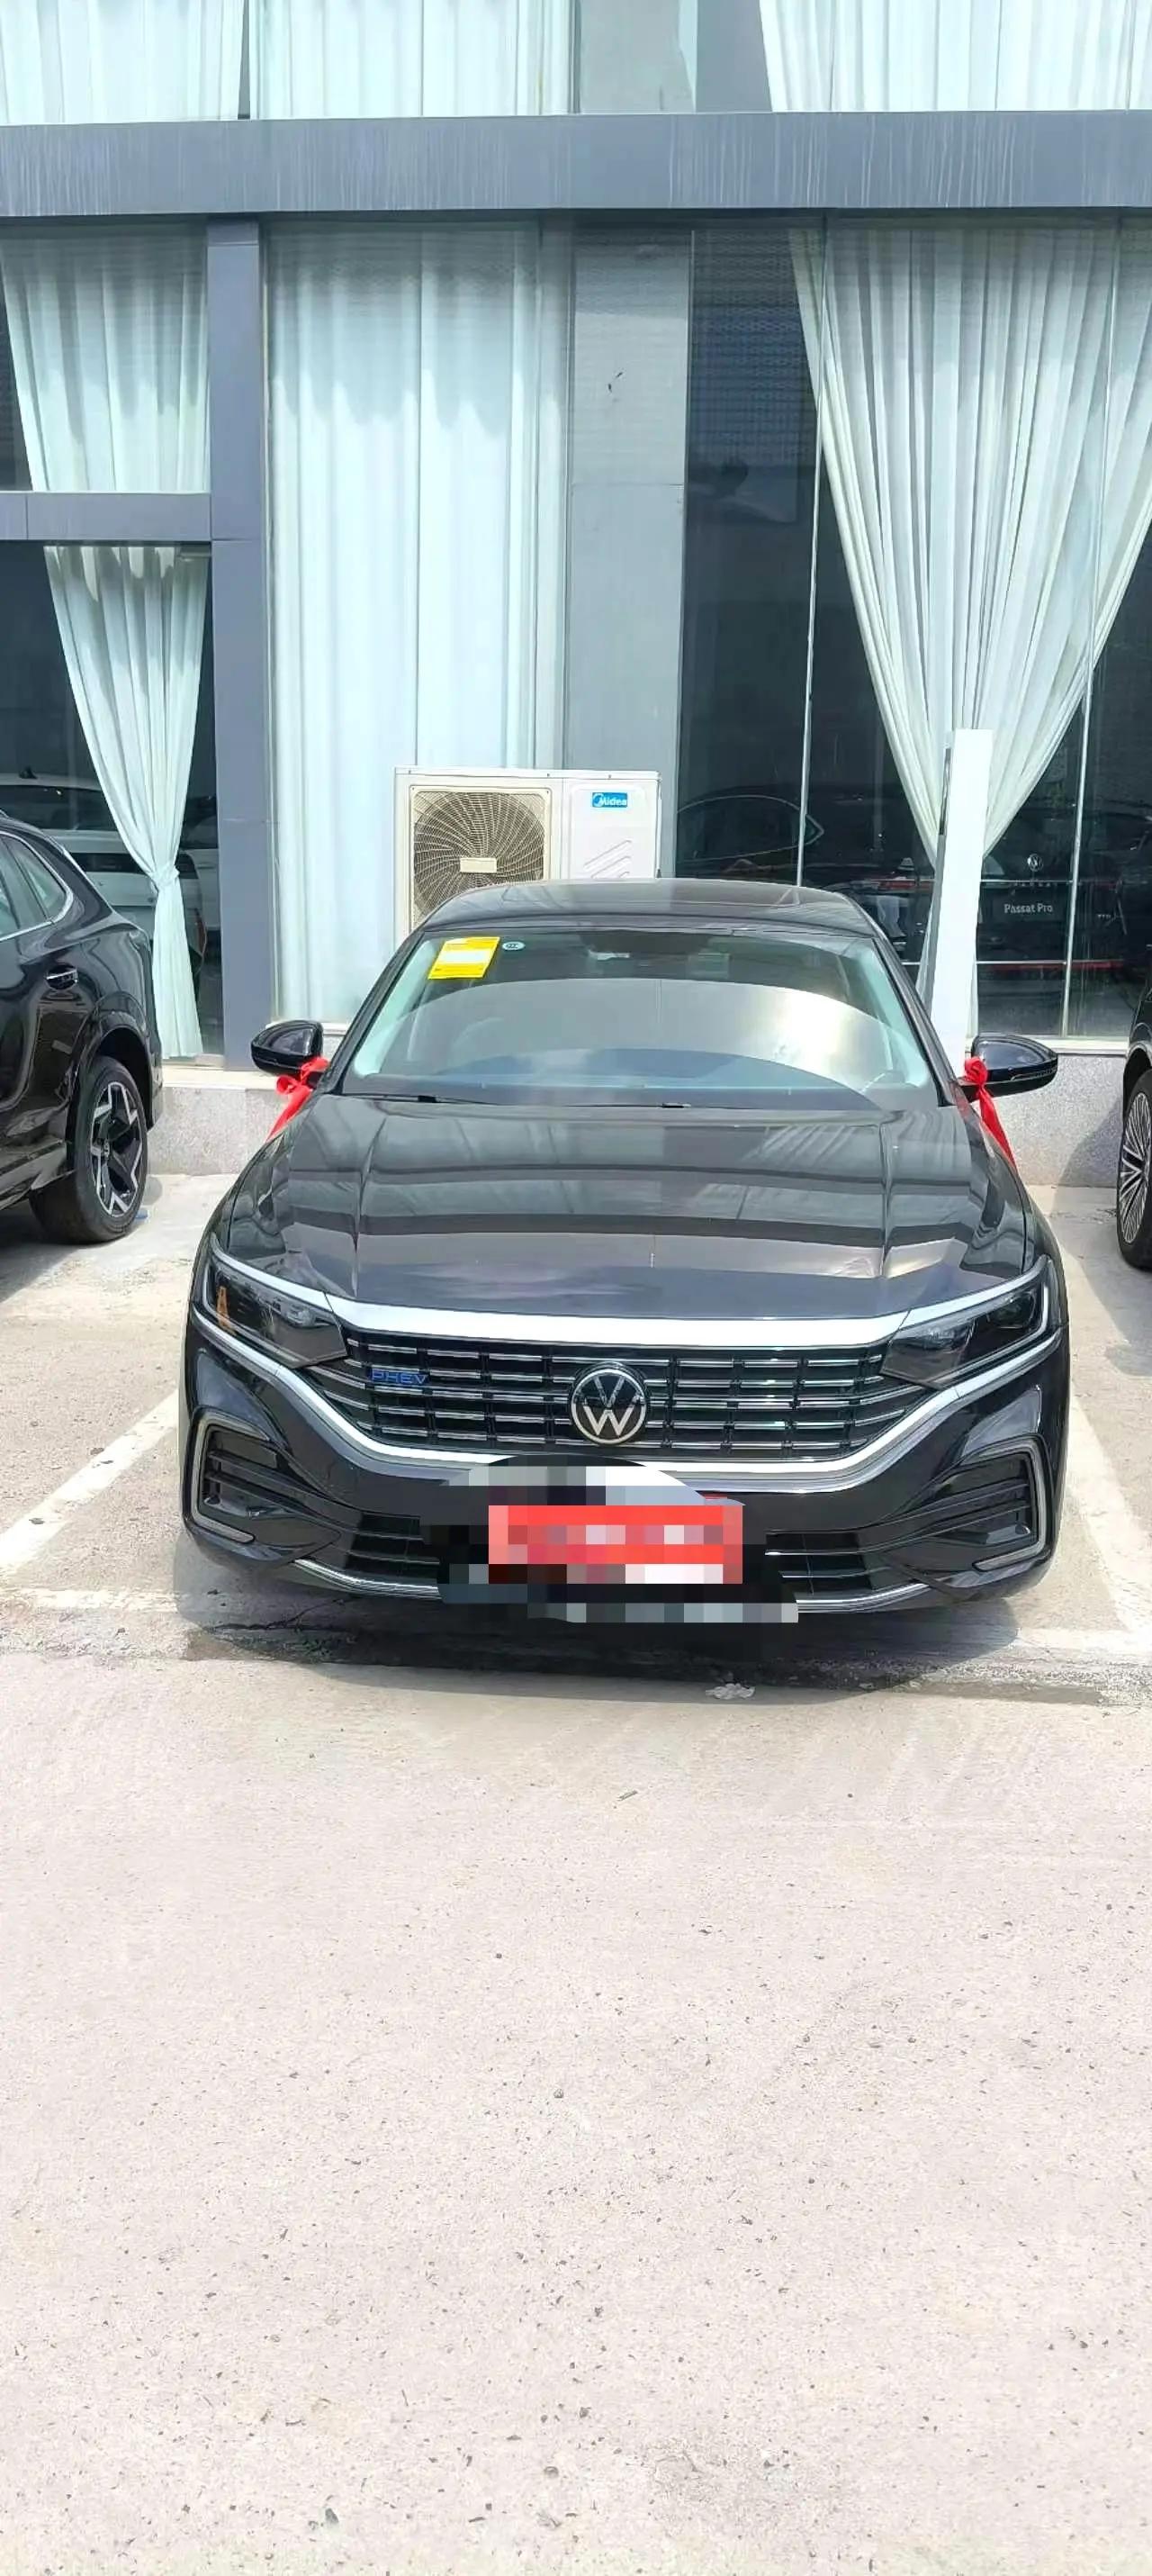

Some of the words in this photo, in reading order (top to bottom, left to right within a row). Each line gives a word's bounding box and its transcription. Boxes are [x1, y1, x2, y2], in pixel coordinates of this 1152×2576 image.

[594, 794, 627, 806] Midea
[1004, 903, 1036, 914] Passat
[1037, 903, 1053, 912] Pro
[372, 1369, 428, 1385] PHEV
